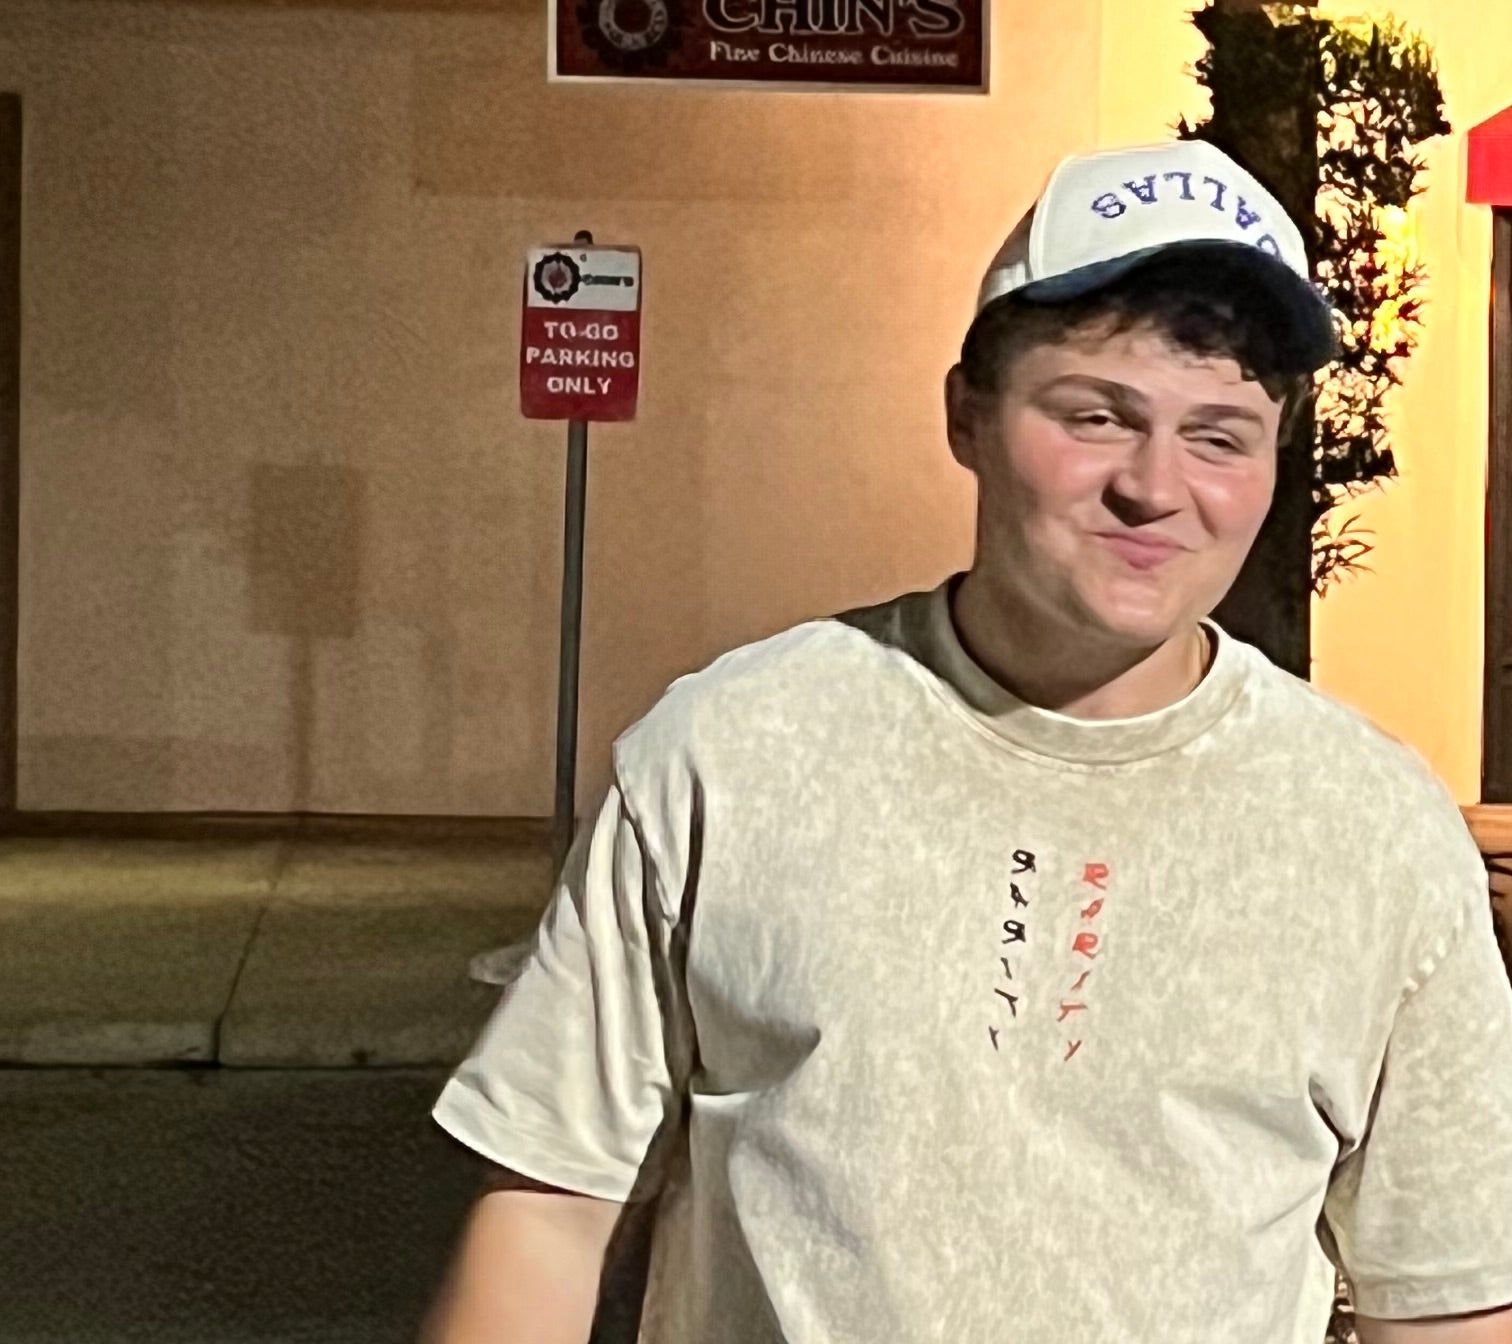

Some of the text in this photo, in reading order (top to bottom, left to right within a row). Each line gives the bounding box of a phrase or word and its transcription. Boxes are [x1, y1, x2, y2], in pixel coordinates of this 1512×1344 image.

[709, 40, 960, 67] Fine Chinese Cuisine
[1091, 171, 1283, 262] DALLAS
[525, 346, 635, 368] PARKING
[546, 376, 612, 395] ONLY
